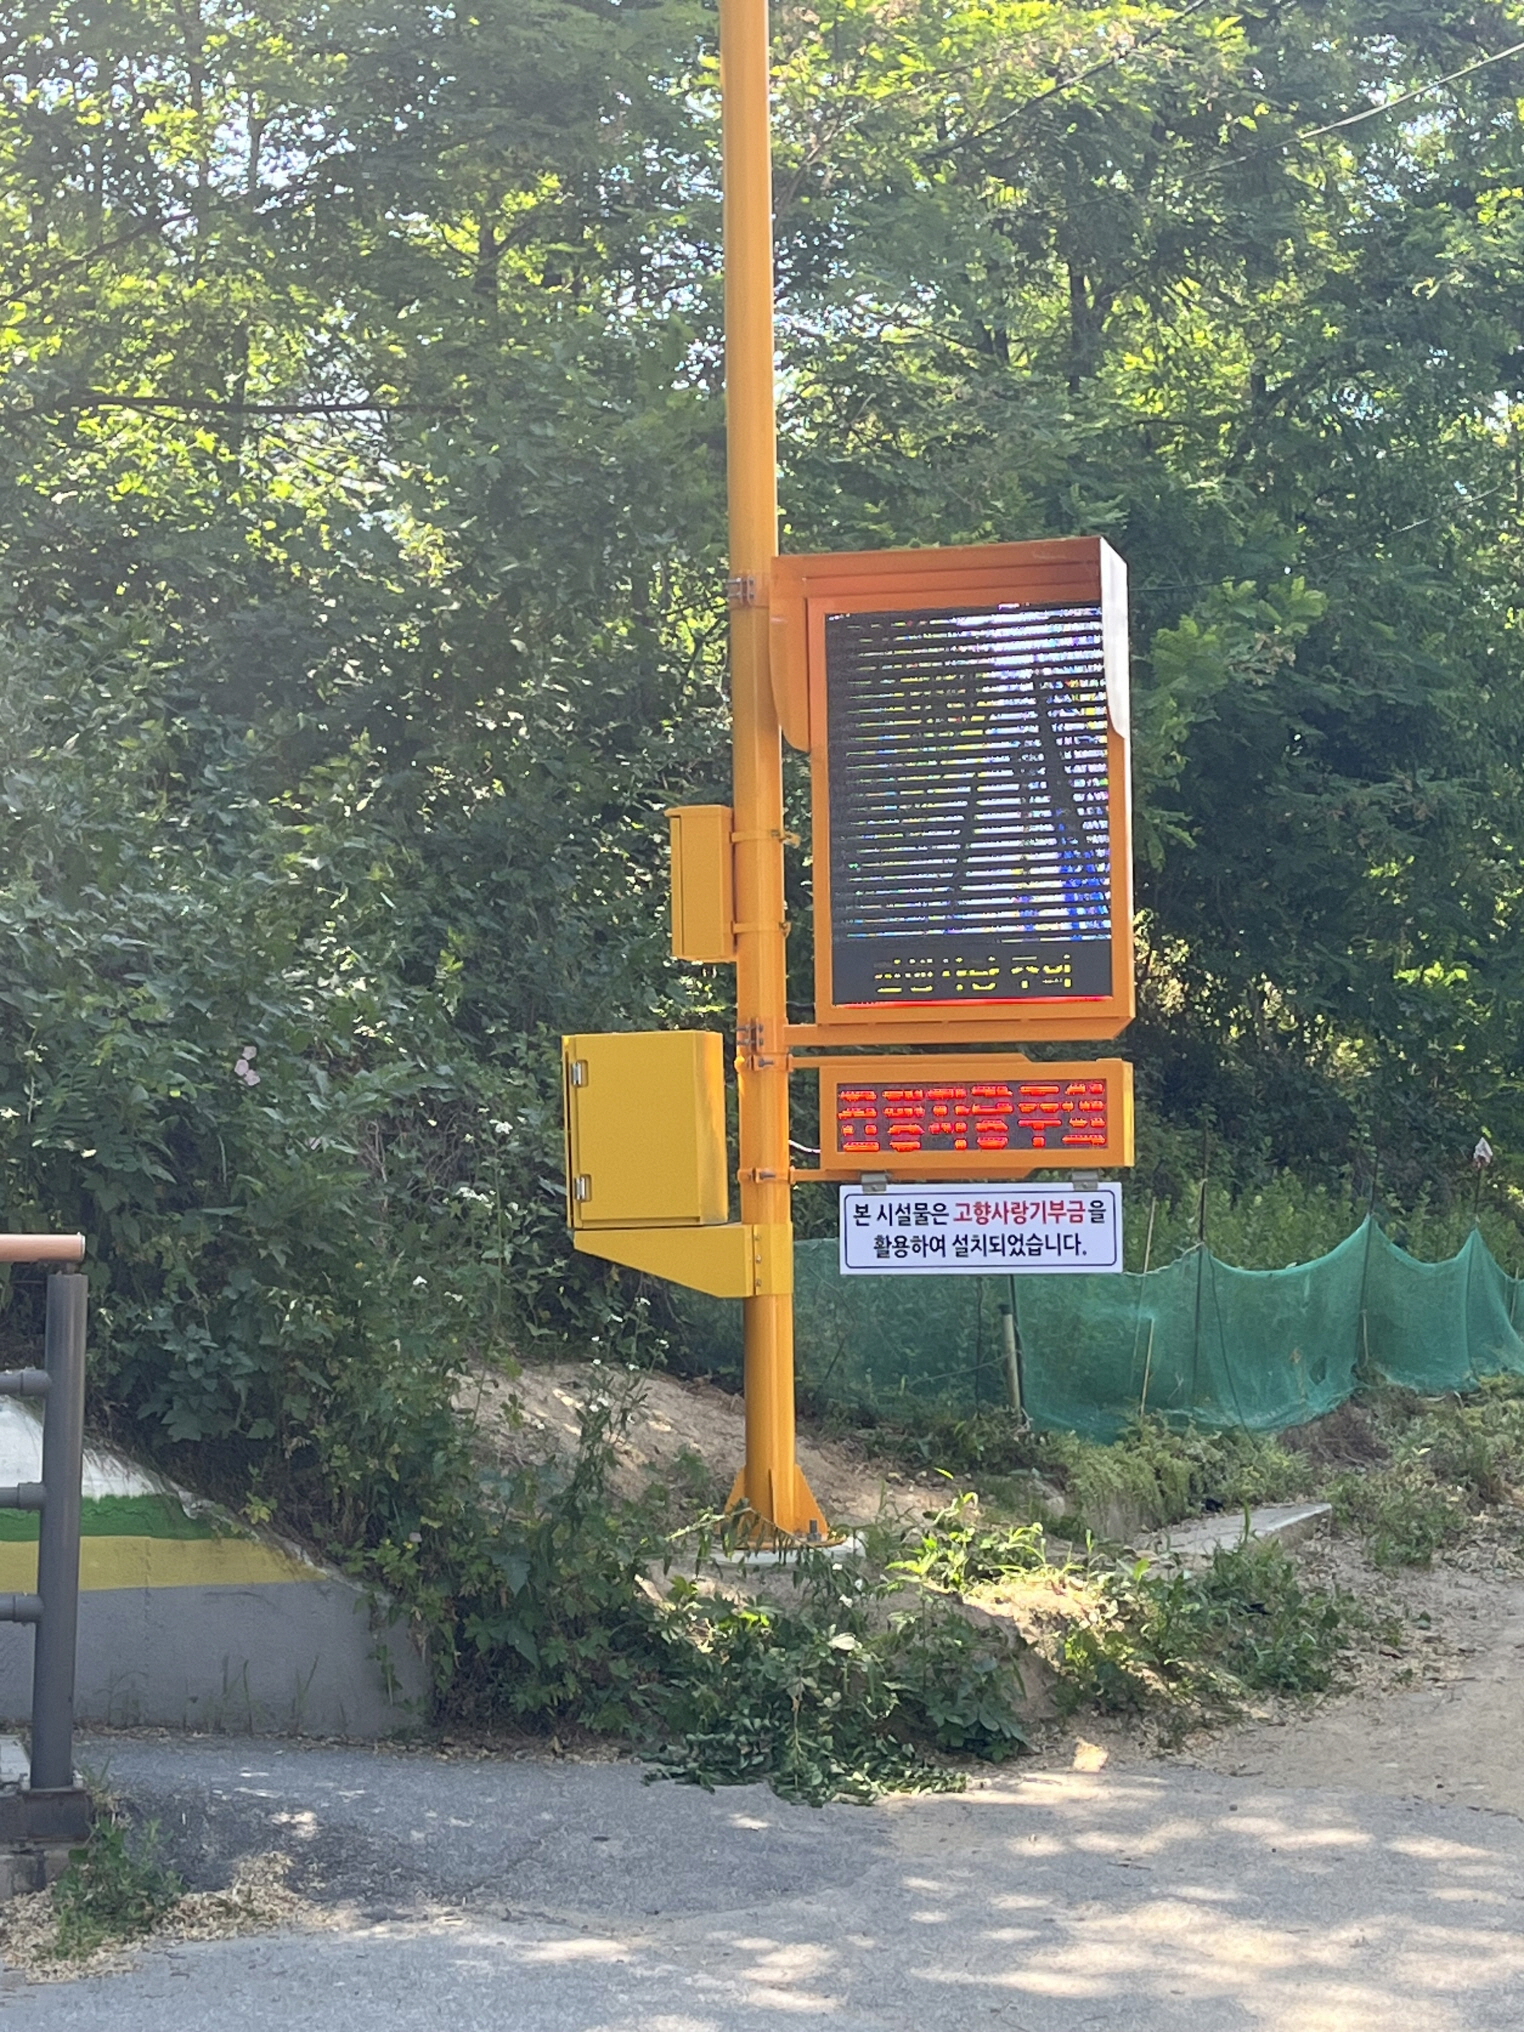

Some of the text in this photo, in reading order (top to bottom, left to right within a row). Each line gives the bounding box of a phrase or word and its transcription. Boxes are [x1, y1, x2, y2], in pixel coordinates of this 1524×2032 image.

[853, 1200, 1106, 1227] 본 시설물은 고향사랑기부금을
[873, 1232, 1088, 1259] 활용하여 설치되었습니다.
